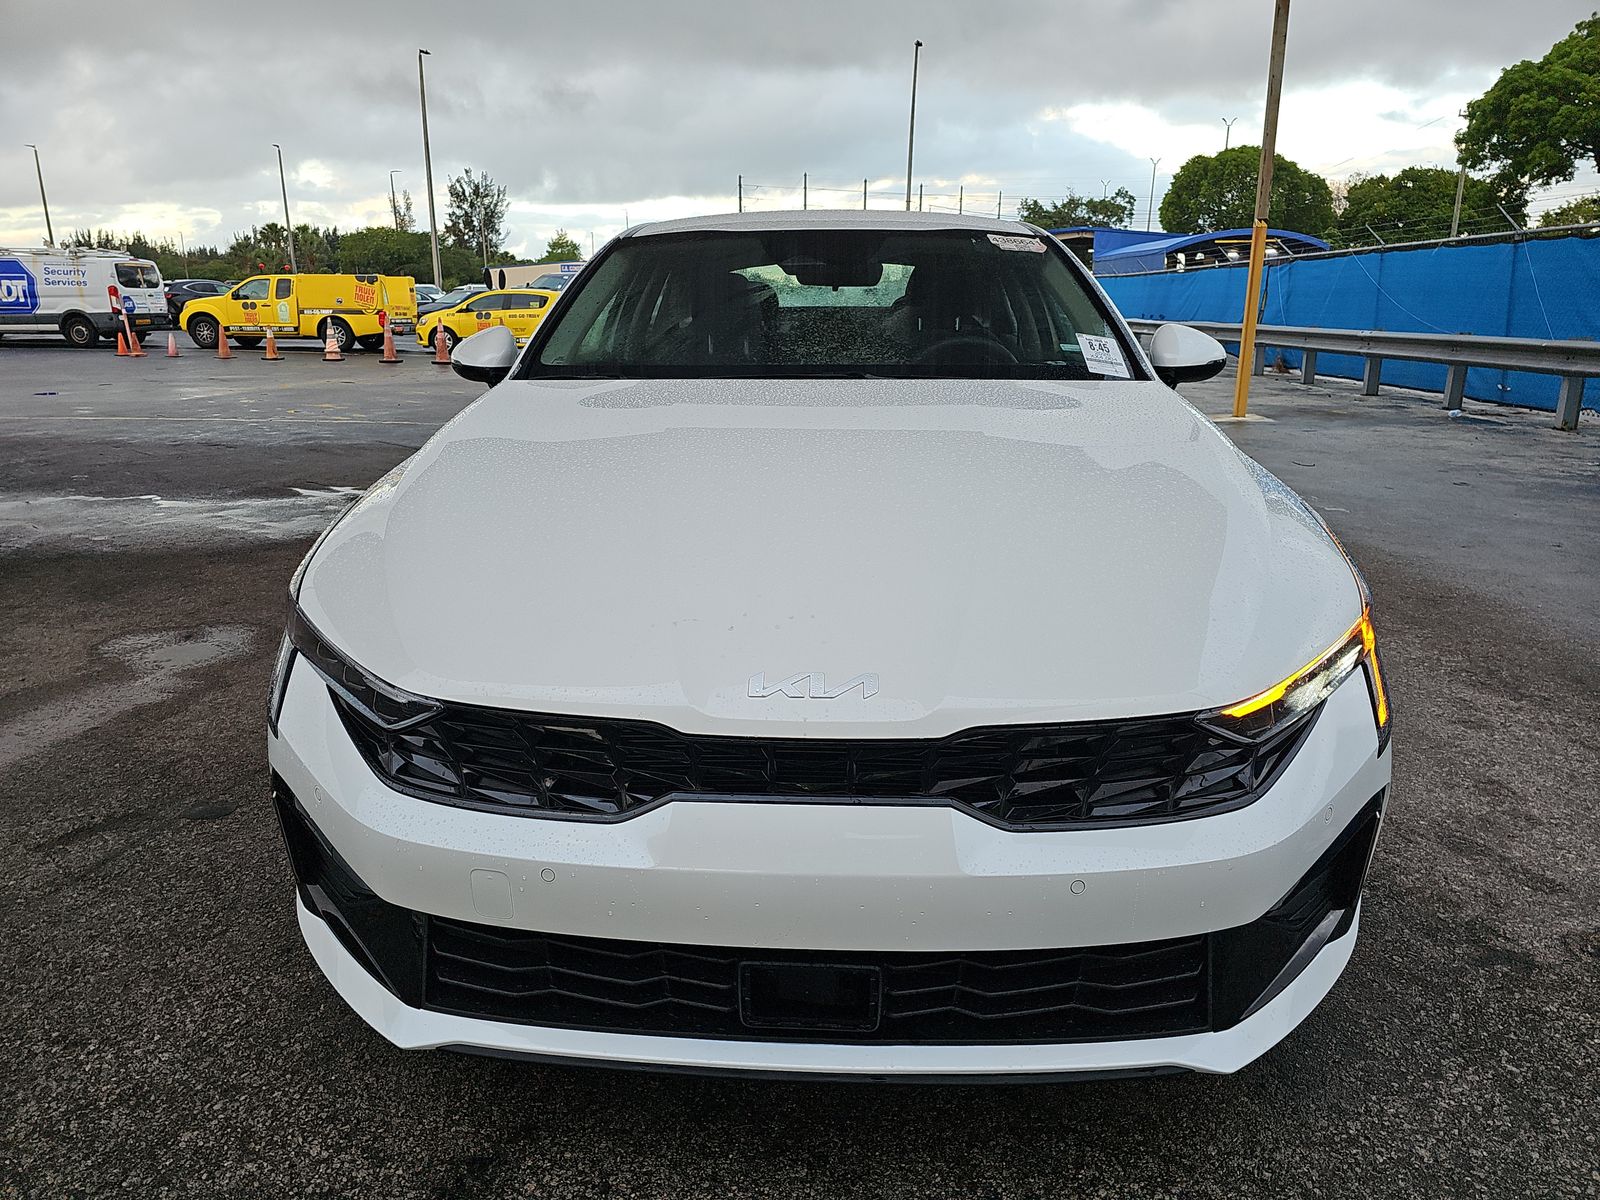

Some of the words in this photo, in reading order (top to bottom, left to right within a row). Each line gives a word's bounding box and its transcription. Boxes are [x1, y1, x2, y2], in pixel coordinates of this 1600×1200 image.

[43, 267, 87, 278] Security
[44, 277, 88, 287] Services
[355, 285, 376, 296] TRULY
[354, 293, 375, 303] NOLEN
[1088, 341, 1110, 353] 8:45
[747, 671, 879, 699] KIA
